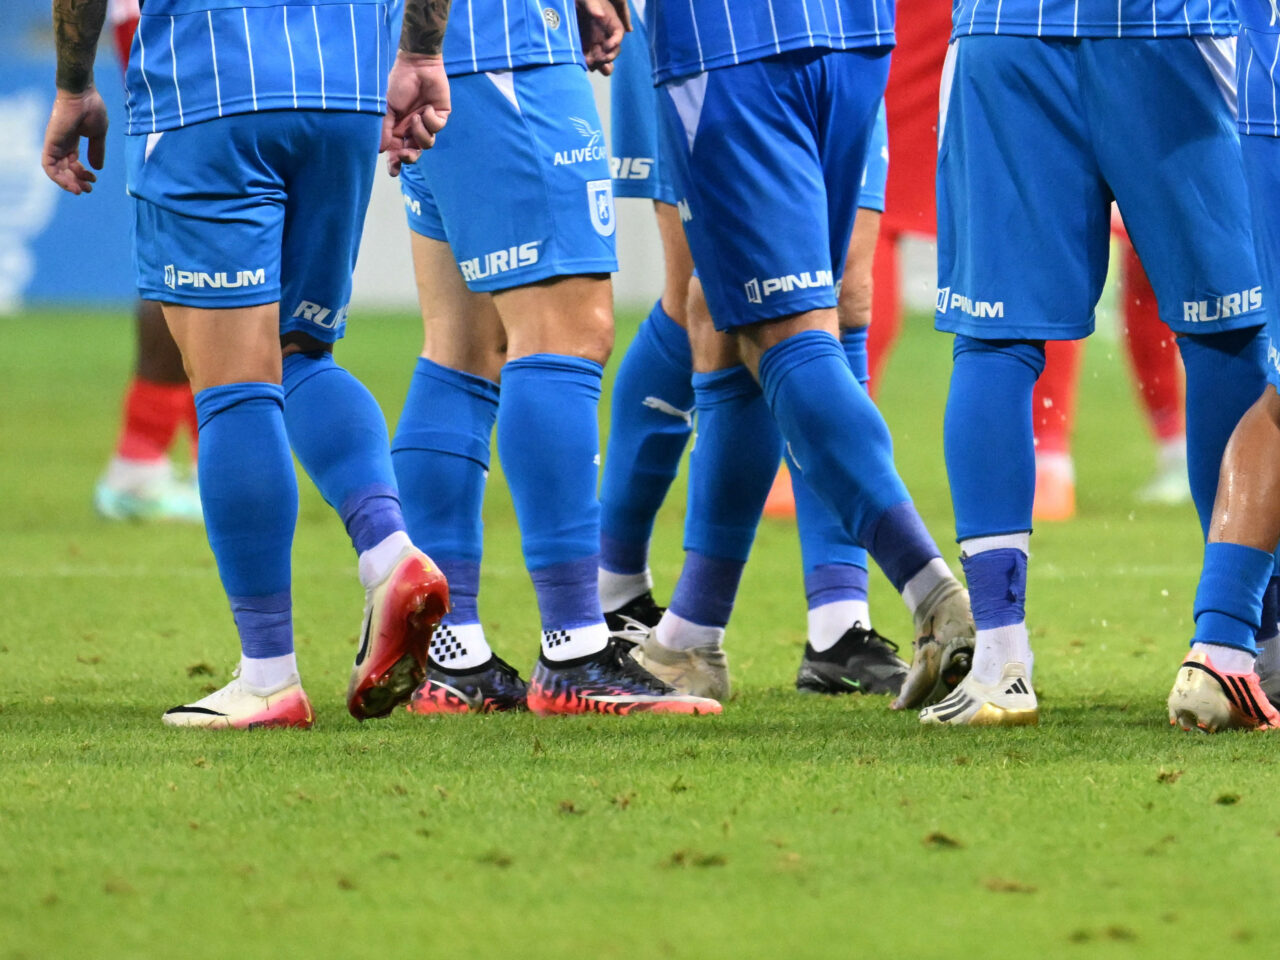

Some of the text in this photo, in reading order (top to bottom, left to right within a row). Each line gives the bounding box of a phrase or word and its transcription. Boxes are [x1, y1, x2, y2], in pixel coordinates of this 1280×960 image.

[460, 241, 540, 282] RURIS
[177, 268, 265, 288] PINUM
[762, 270, 833, 296] PINUM
[1183, 285, 1262, 322] RURIS
